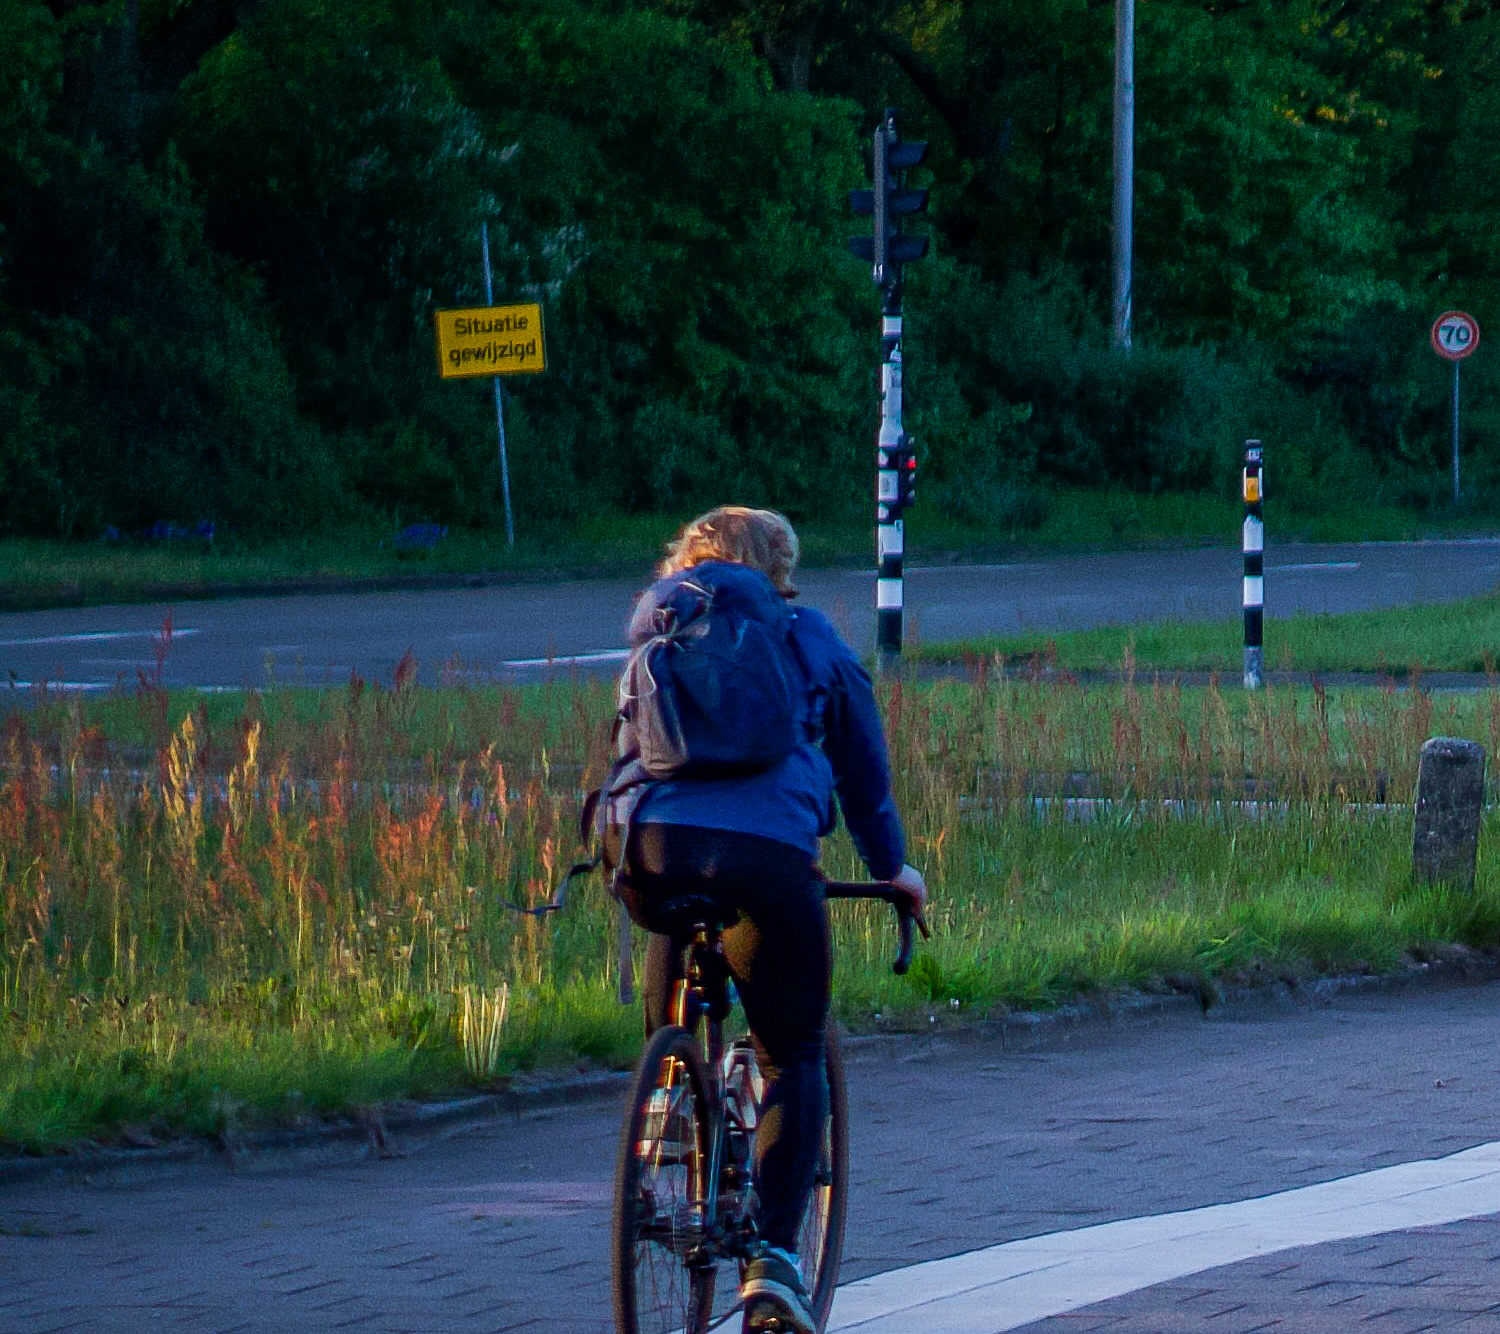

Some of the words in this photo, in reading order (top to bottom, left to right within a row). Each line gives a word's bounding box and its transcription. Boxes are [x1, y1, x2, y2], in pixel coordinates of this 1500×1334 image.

[455, 314, 529, 336] Situatie
[1440, 326, 1470, 345] 70
[449, 338, 536, 367] gewijzigd
